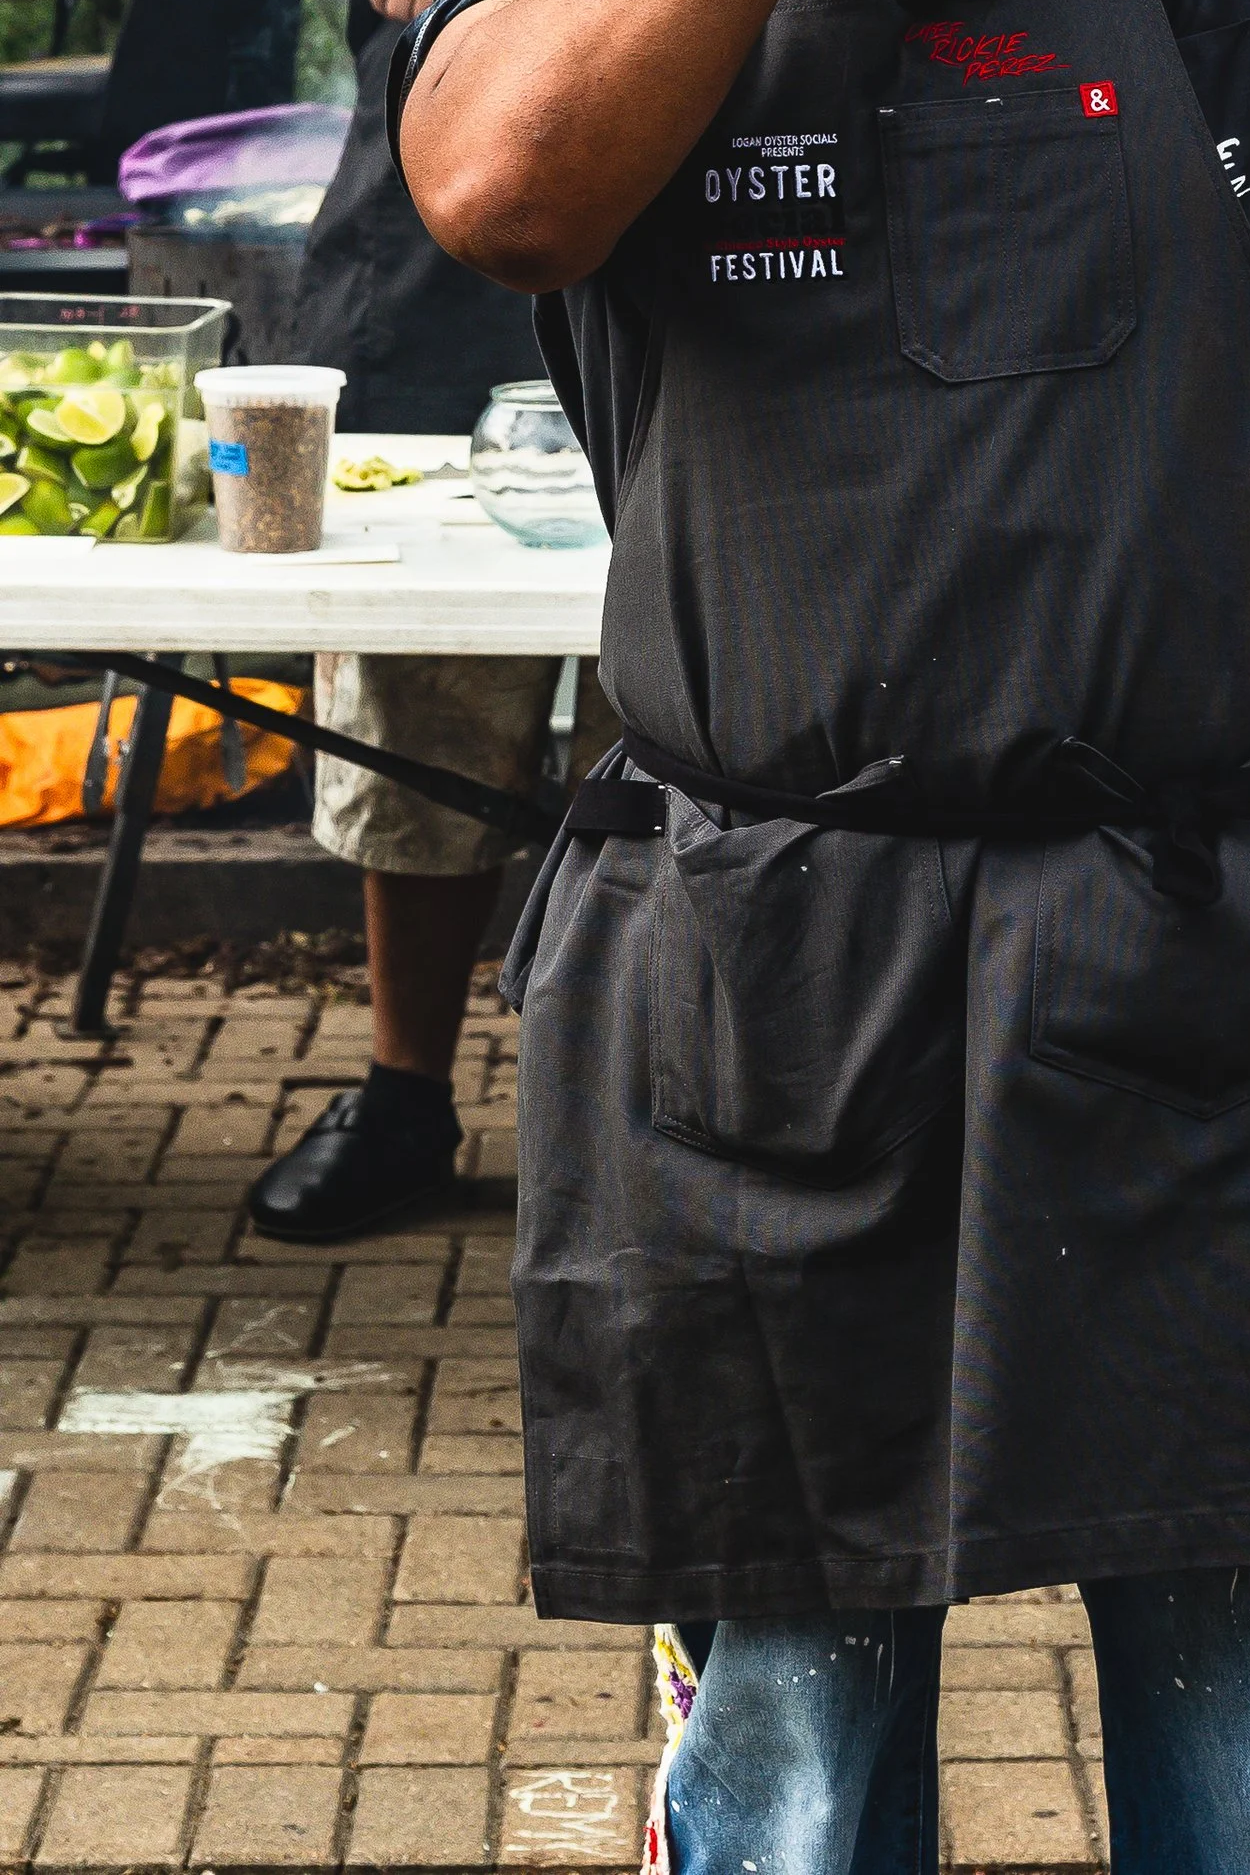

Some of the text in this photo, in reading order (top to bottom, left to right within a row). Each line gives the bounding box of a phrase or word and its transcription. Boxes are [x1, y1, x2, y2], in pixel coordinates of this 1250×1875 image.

[930, 31, 1029, 67] RICKIE
[962, 53, 1071, 87] PEREZ
[1090, 88, 1111, 112] &
[732, 133, 838, 148] LOGAN OYSTER SOCIALS
[761, 146, 804, 157] PRESENTS
[705, 163, 837, 203] OYSTER
[766, 237, 799, 249] Style
[803, 236, 846, 248] Oyster
[710, 248, 844, 282] FESTIVAL
